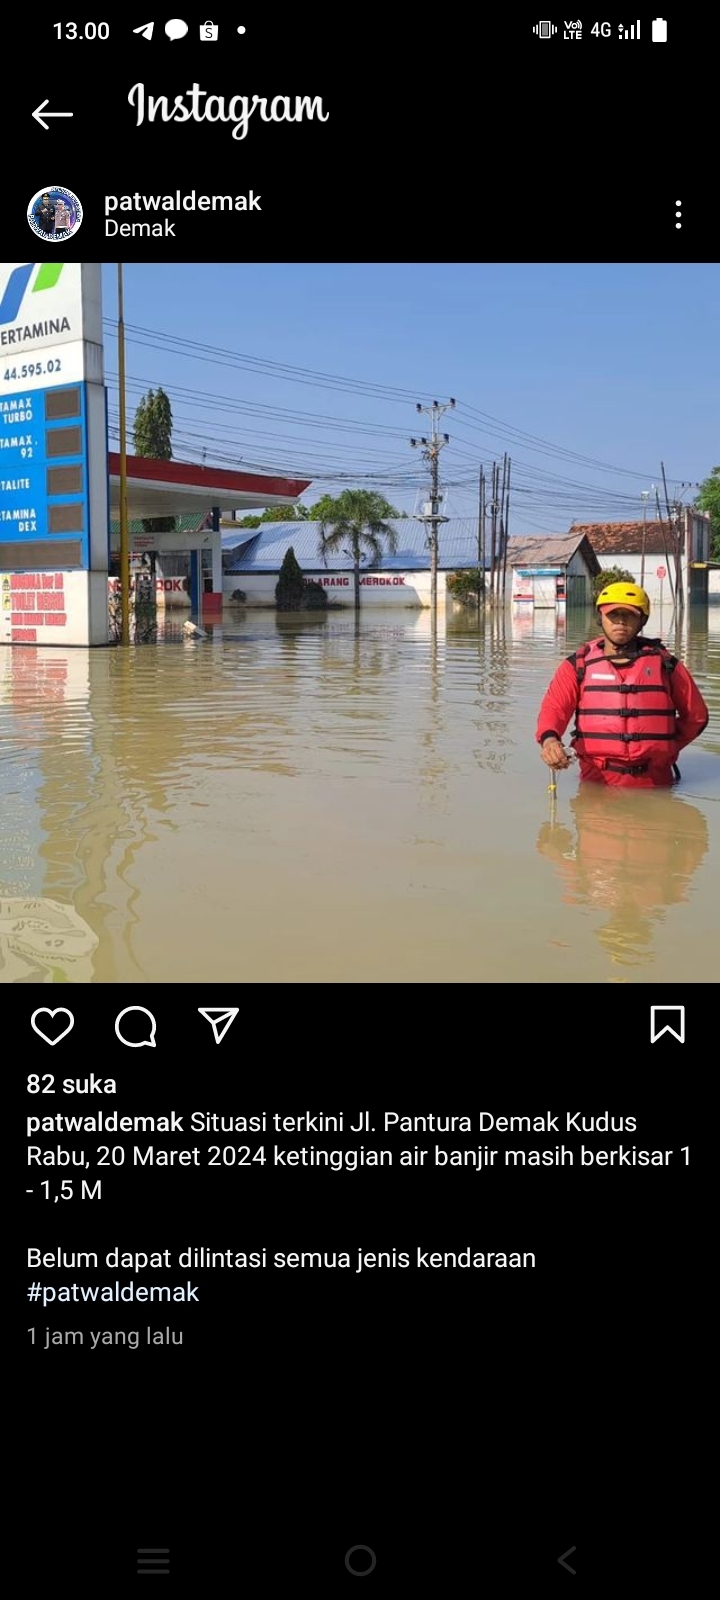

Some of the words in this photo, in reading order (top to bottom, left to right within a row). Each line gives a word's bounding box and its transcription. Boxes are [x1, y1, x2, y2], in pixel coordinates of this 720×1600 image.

[54, 22, 110, 40] 13.00
[564, 30, 582, 40] LTE
[591, 22, 612, 38] 4G
[128, 83, 330, 140] Instagram
[105, 190, 262, 216] patwaldemak
[105, 218, 176, 237] Demak
[0, 316, 71, 346] ERTAMINA
[3, 358, 62, 381] 44.595.02
[0, 397, 32, 412] TAMAX
[3, 409, 33, 424] TURBO
[0, 434, 32, 449] TAMAX
[20, 446, 34, 459] 92
[0, 478, 30, 491] TALITE
[0, 508, 37, 521] TAMINA
[18, 520, 37, 533] DEX
[27, 1074, 56, 1094] 82
[63, 1073, 117, 1094] suka
[27, 1111, 184, 1137] patwaldemak
[191, 1112, 266, 1132] Situasi
[273, 1111, 343, 1132] terkini
[350, 1111, 375, 1132] Jl.
[385, 1112, 471, 1132] Pantura
[480, 1111, 559, 1132] Demak
[567, 1111, 636, 1132] Kudus
[28, 1145, 89, 1169] Rabu,
[97, 1146, 124, 1166] 20
[134, 1146, 200, 1166] Maret
[208, 1146, 266, 1166] 2024
[274, 1145, 392, 1171] ketinggian
[400, 1145, 428, 1166] air
[435, 1145, 498, 1171] banjir
[505, 1145, 573, 1166] masih
[581, 1145, 673, 1166] berkisar
[681, 1146, 690, 1166] 1
[41, 1180, 73, 1203] 1,5
[82, 1180, 102, 1200] M
[28, 1247, 97, 1268] Belum
[106, 1247, 171, 1273] dapat
[179, 1247, 266, 1268] dilintasi
[274, 1253, 350, 1268] semua
[356, 1248, 409, 1273] jenis
[417, 1247, 535, 1268] kendaraan
[27, 1281, 199, 1307] #patwaldemak
[28, 1328, 36, 1345] 1
[44, 1327, 83, 1349] jam
[90, 1332, 138, 1349] yang
[148, 1327, 183, 1345] lalu
